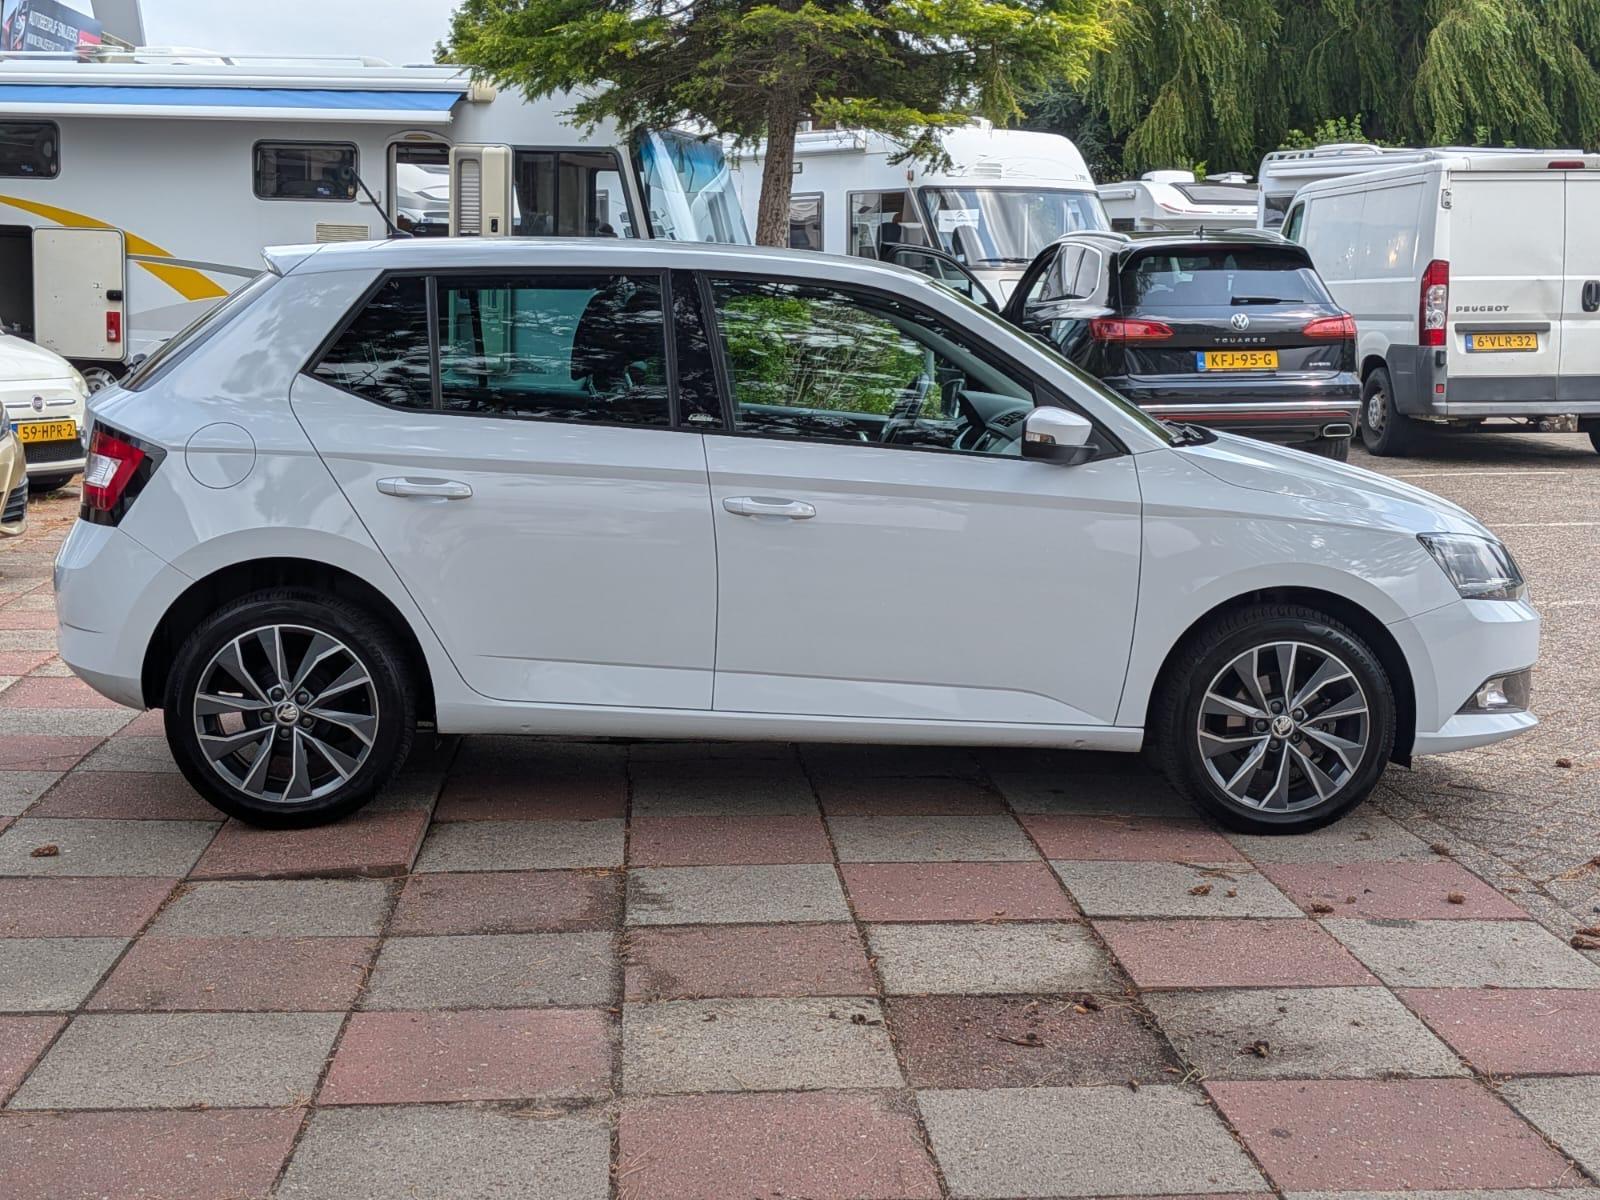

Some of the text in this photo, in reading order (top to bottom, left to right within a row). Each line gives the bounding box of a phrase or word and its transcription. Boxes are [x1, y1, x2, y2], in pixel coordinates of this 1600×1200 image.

[1477, 335, 1532, 347] 6-VLR-32
[1210, 353, 1272, 366] KFJ-95-G
[22, 423, 73, 440] 59-HPR-2
